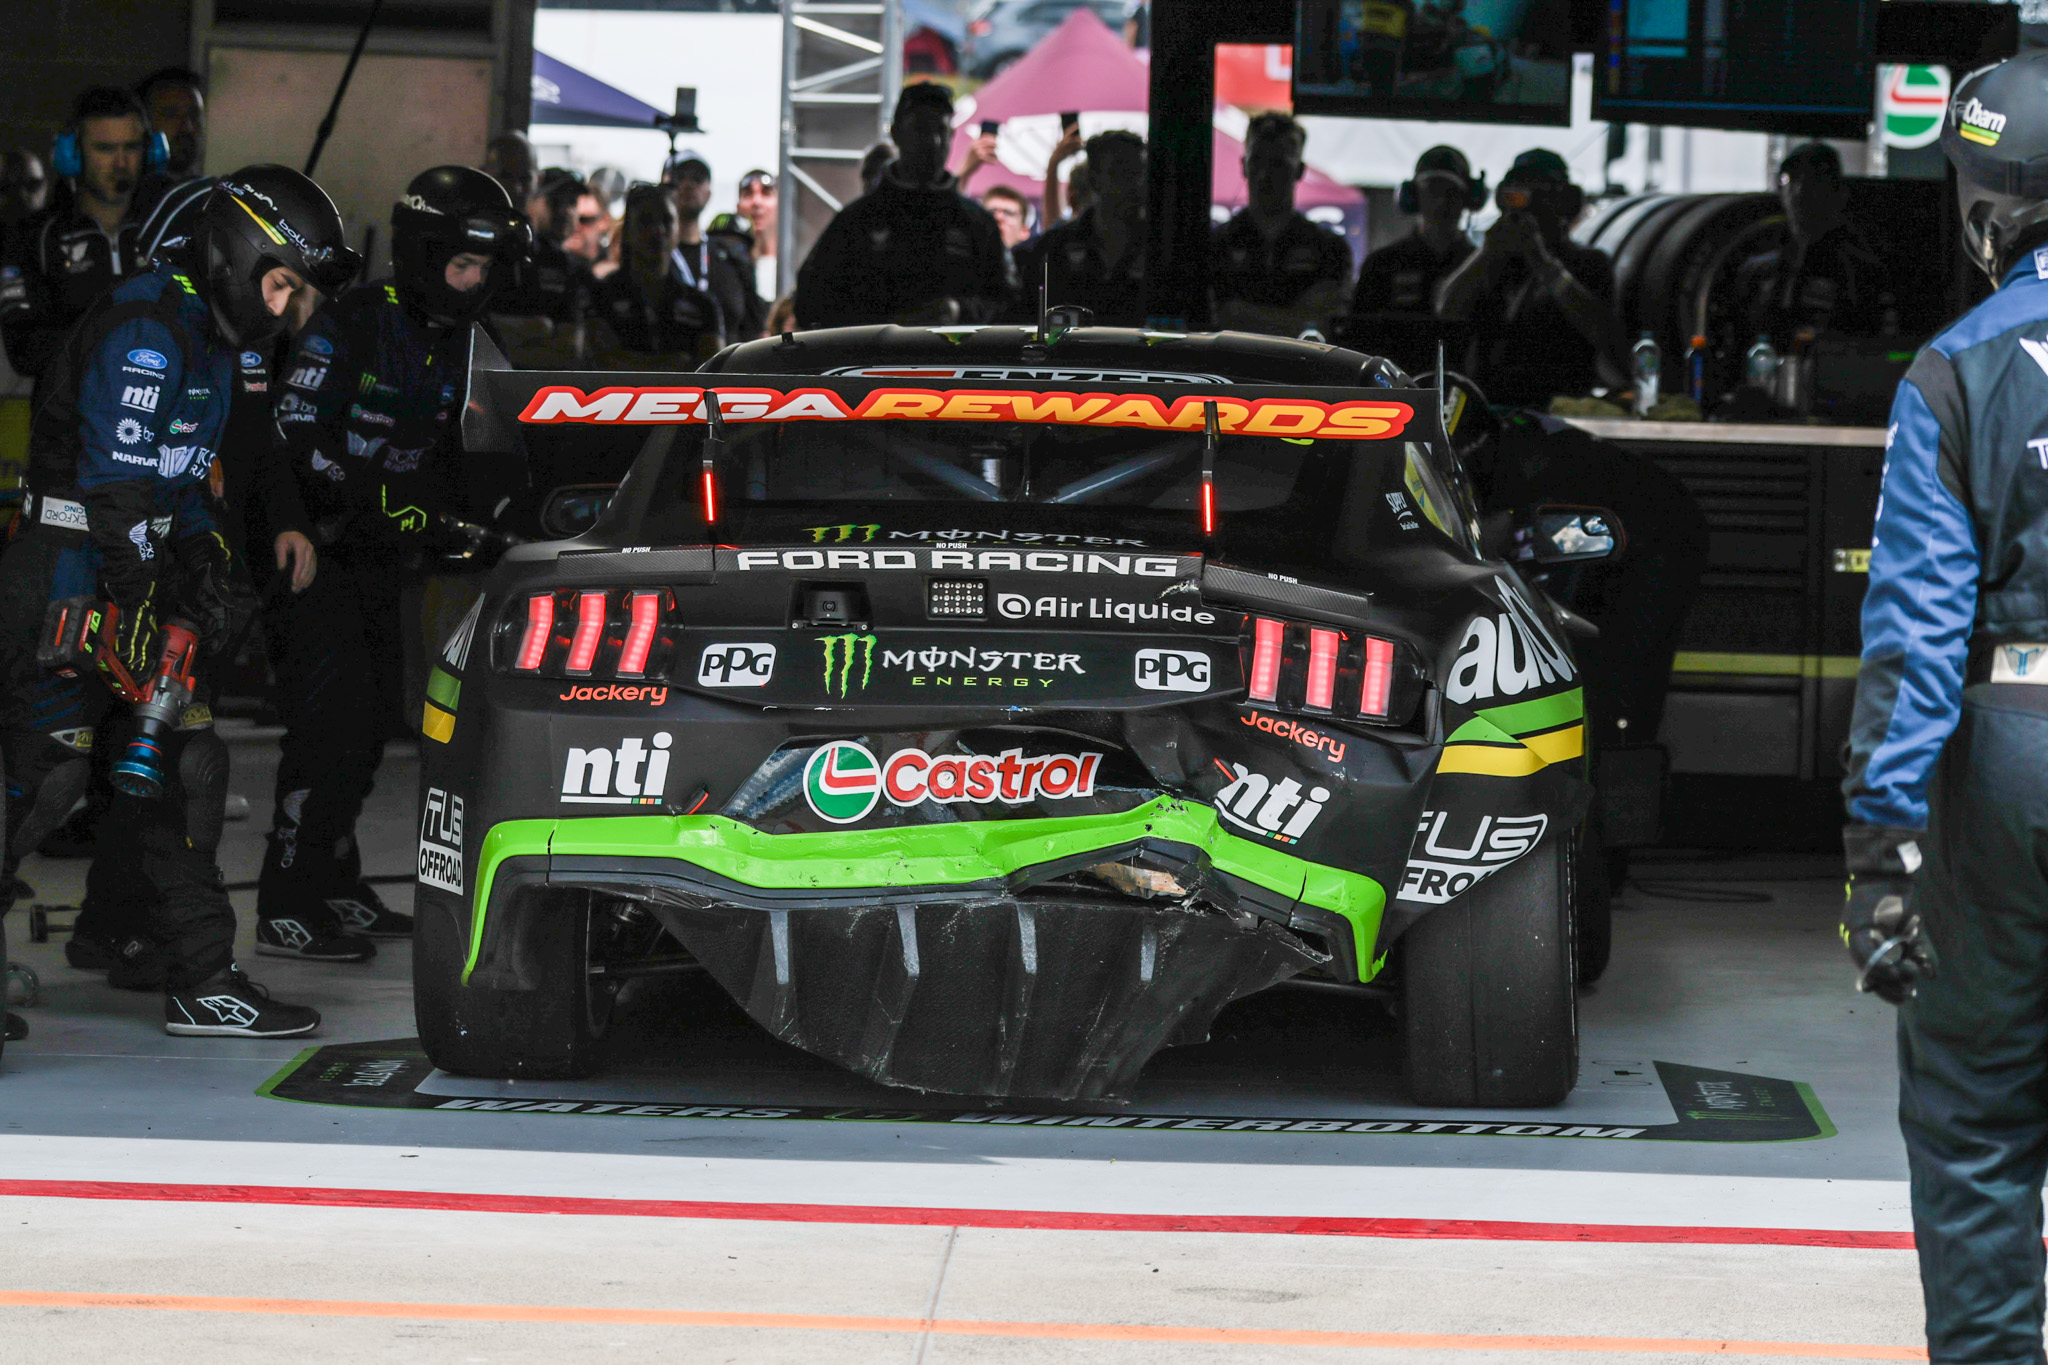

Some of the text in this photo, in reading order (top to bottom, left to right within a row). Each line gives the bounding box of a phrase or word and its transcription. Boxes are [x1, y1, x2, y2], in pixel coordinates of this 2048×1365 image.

[135, 352, 161, 367] Ford
[122, 366, 166, 380] RACING
[121, 385, 161, 411] nti
[529, 391, 1402, 437] MEGA REWARDS
[142, 426, 155, 443] bp
[112, 451, 159, 467] NARVA
[45, 509, 88, 525] CKFORD
[64, 505, 84, 514] CING
[889, 529, 1149, 547] MONSTER
[737, 551, 1178, 577] FORD RACING
[1268, 572, 1298, 585] NO PUSH
[1034, 596, 1216, 625] Air Liquide
[702, 646, 772, 683] PPG
[882, 646, 1086, 676] MONSTER
[1138, 652, 1208, 687] PPG
[912, 676, 1055, 688] ENERGY
[560, 684, 668, 706] Jackery
[1241, 711, 1346, 763] Jackery
[561, 731, 673, 797] nti
[885, 752, 1098, 799] Castrol
[1216, 762, 1331, 839] nti
[420, 848, 462, 888] OFFROAD
[434, 1099, 800, 1118] WATERS
[951, 1114, 1648, 1139] WINTERBOTTOM
